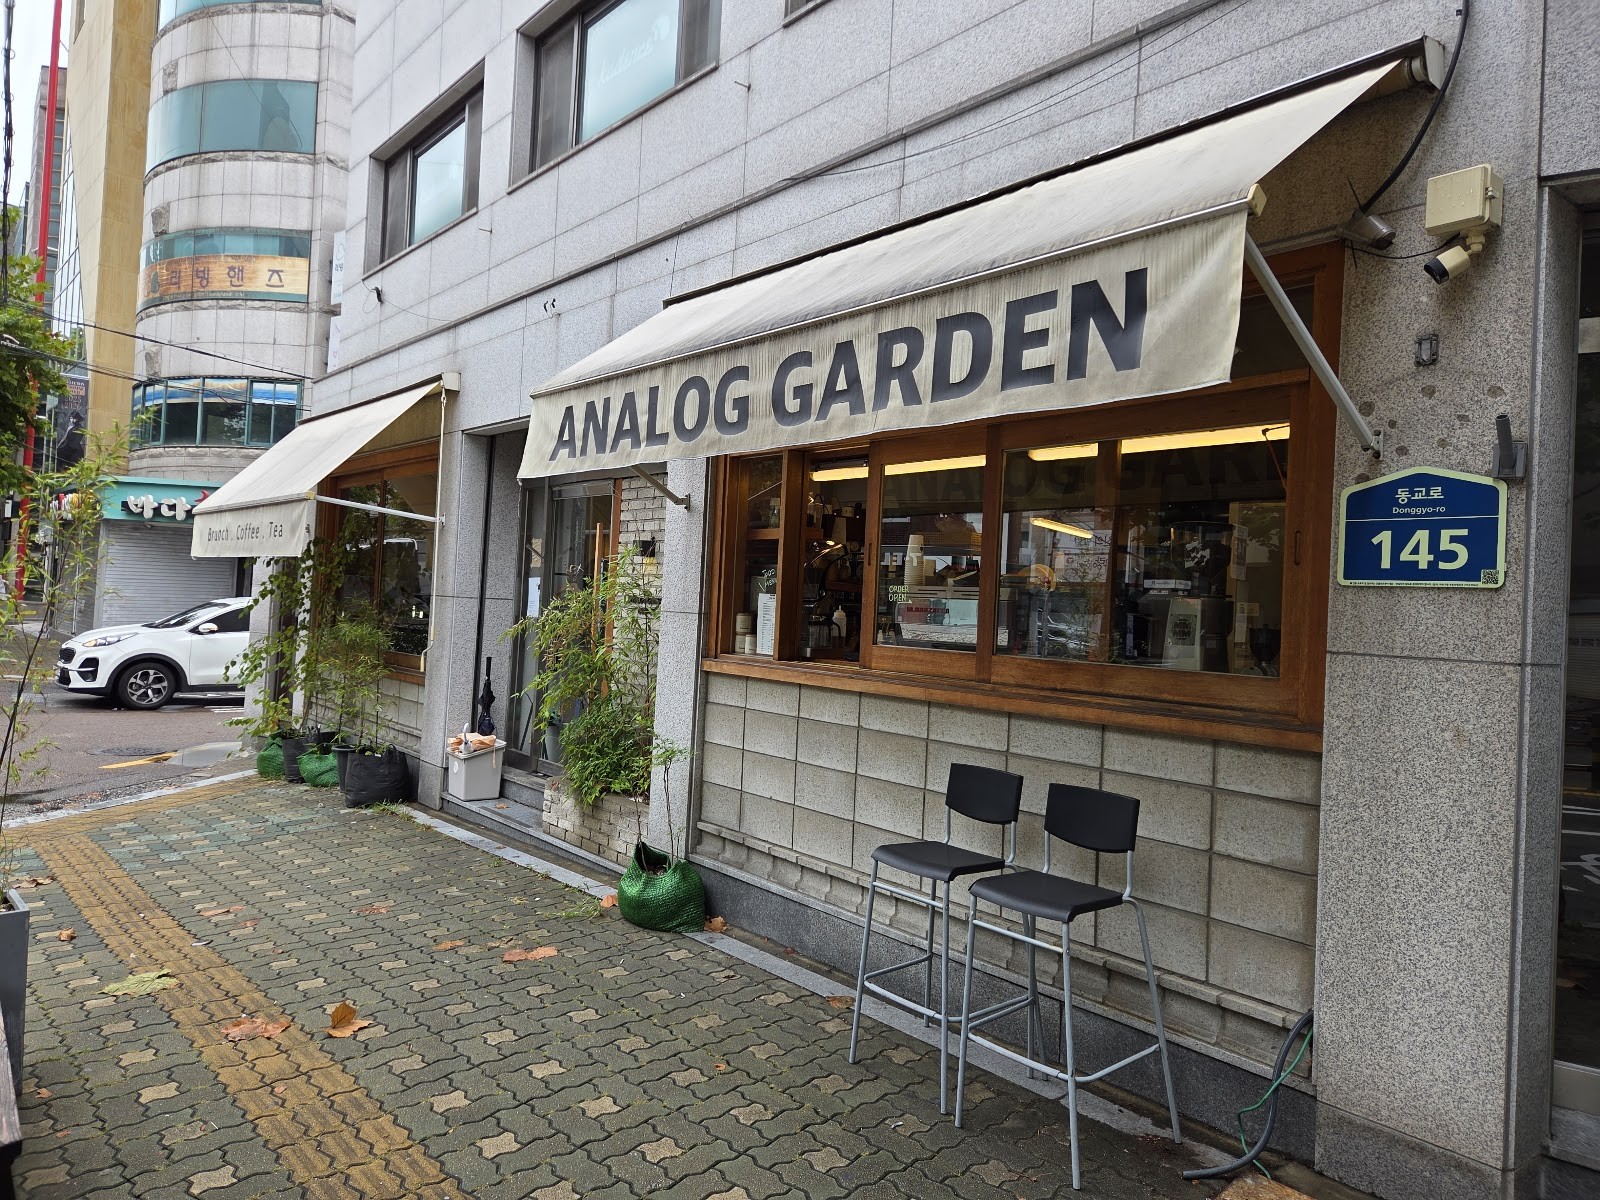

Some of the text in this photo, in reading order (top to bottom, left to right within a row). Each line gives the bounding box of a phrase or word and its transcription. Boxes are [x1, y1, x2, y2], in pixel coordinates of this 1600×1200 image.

[549, 267, 1149, 461] ANALOG GARDEN
[1395, 486, 1445, 504] 동교로
[1392, 505, 1446, 515] Donggyo-ro
[207, 521, 284, 542] Brunch Coffee Tea
[1371, 528, 1469, 570] 145
[888, 584, 910, 593] ORDER
[888, 592, 907, 602] OPEN
